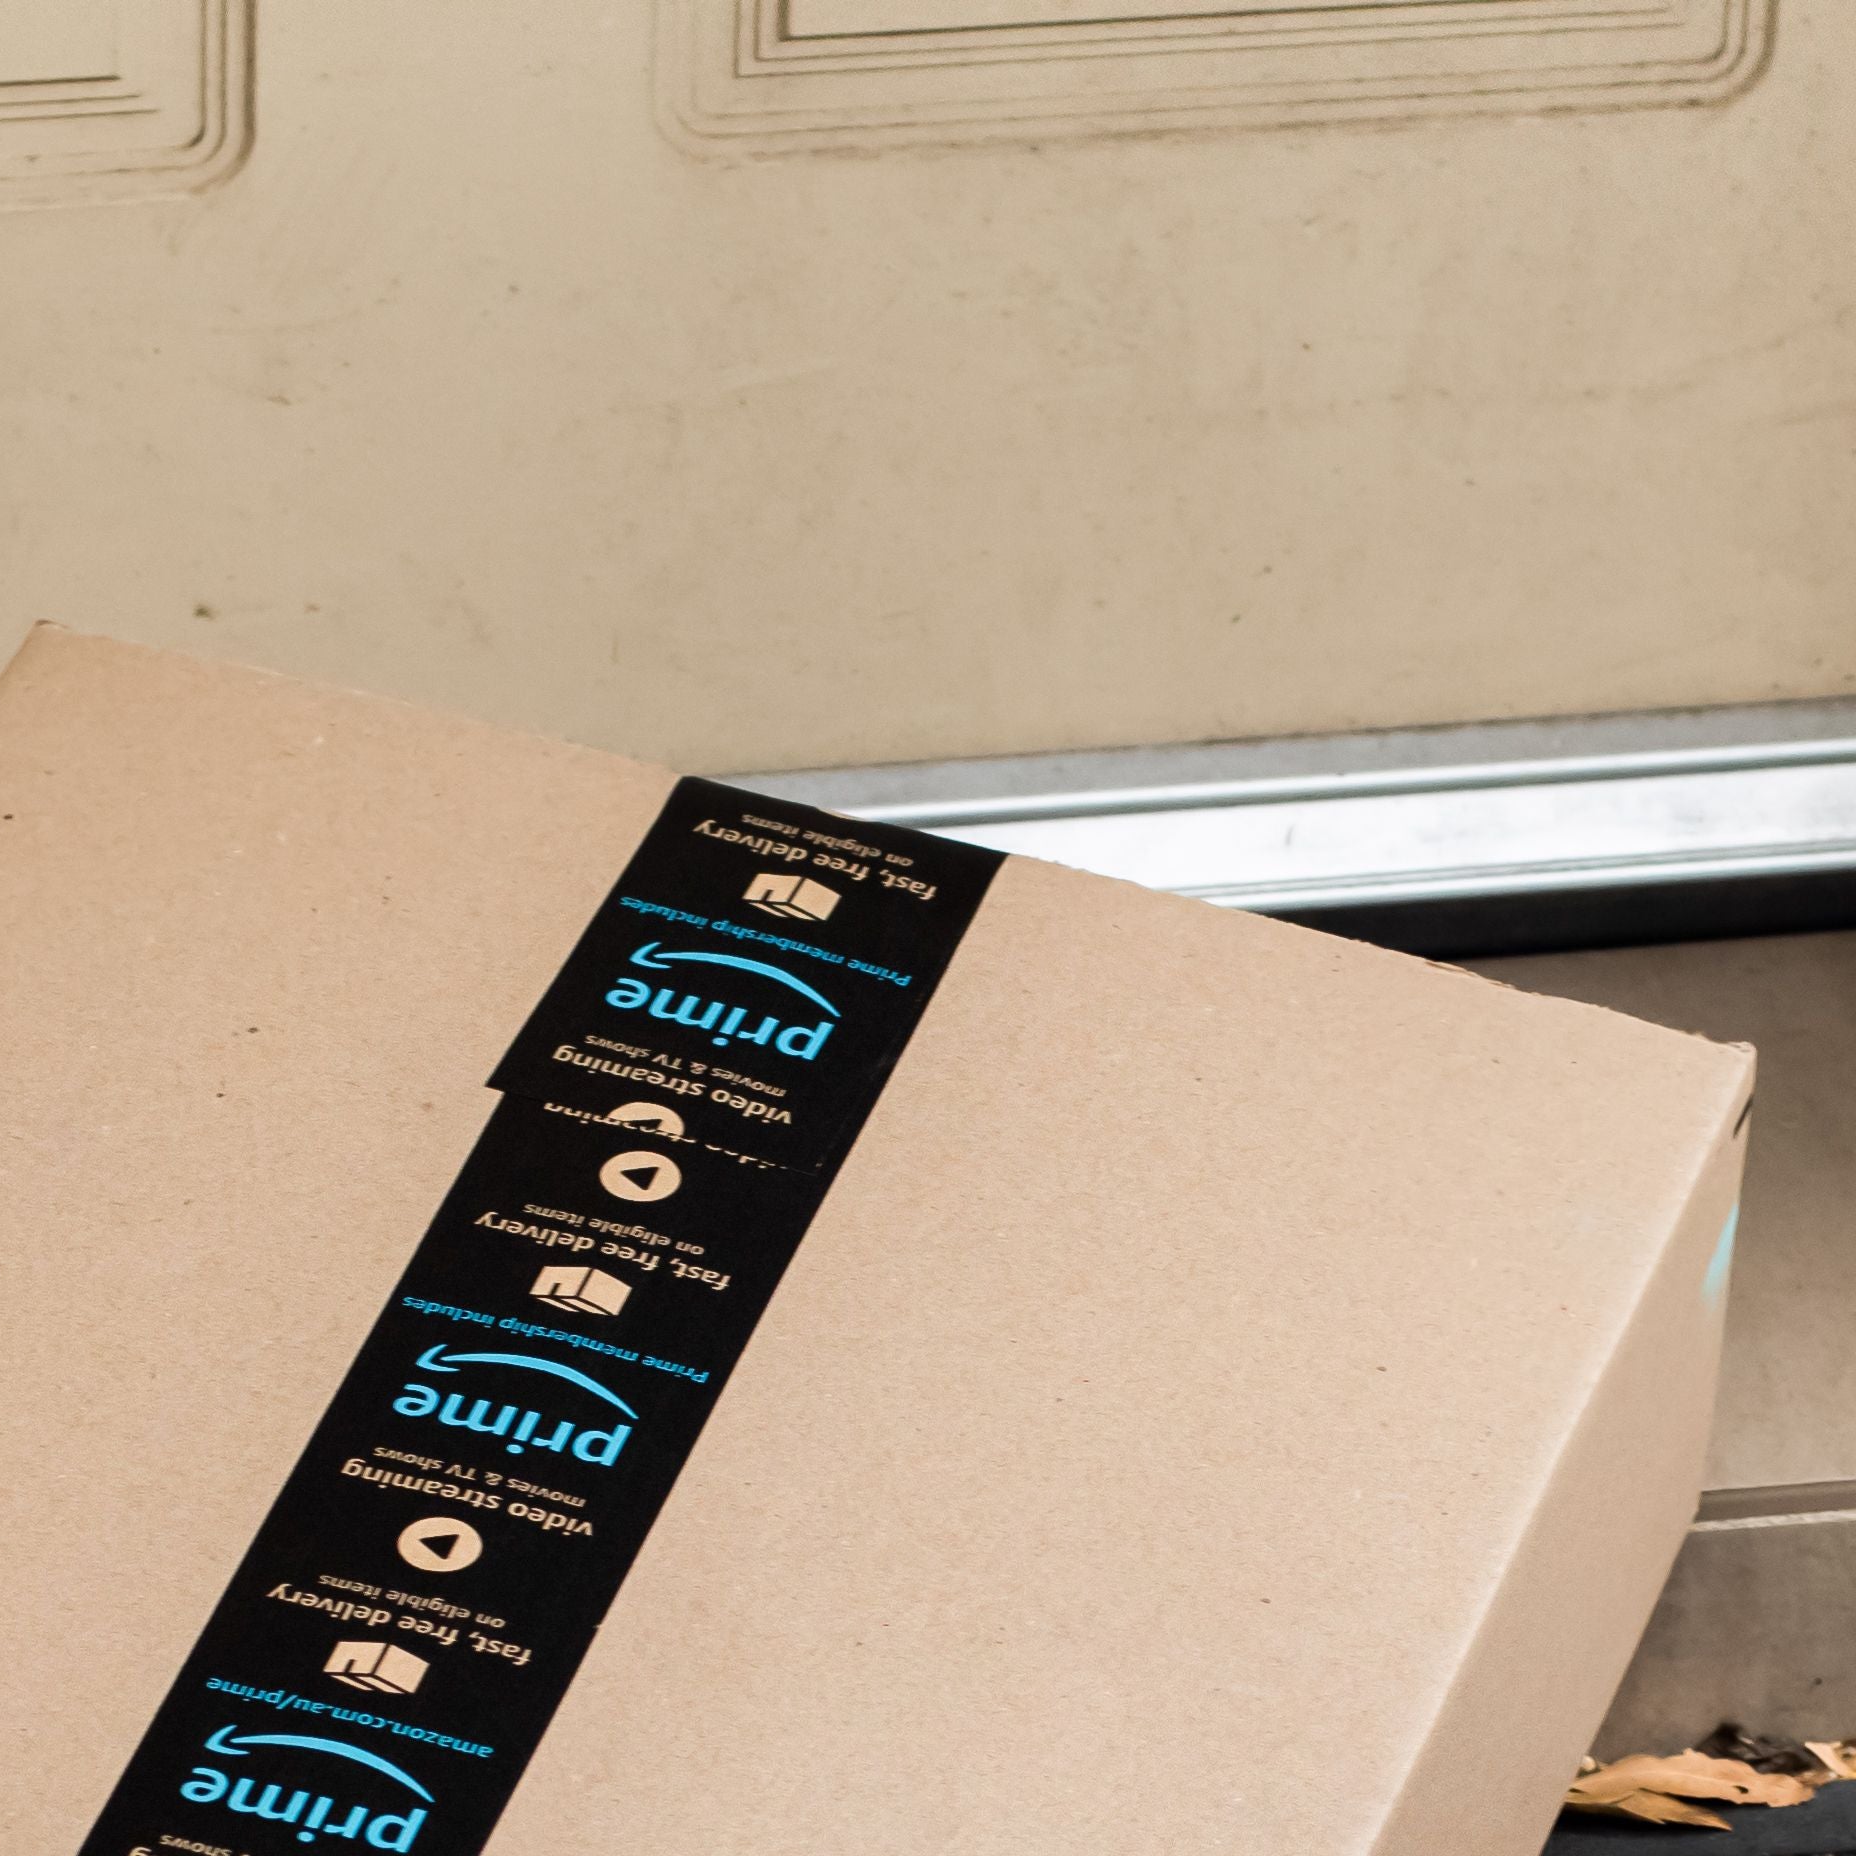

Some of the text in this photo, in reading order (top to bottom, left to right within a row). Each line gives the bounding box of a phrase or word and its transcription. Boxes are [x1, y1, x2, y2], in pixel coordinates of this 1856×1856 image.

[693, 820, 937, 900] fast, free delivery
[742, 815, 913, 866] on eligible items
[620, 897, 912, 986] Prime membership includes
[605, 978, 835, 1060] prime
[552, 1045, 791, 1124] video streaming
[584, 1035, 786, 1096] movies & TV shows
[474, 1212, 731, 1290] fast, free delivery
[522, 1204, 704, 1255] on eligible items
[402, 1297, 709, 1383] Prime membership includes
[392, 1384, 632, 1467] prime
[341, 1458, 592, 1536] video streaming
[373, 1447, 586, 1507] movies & TV shows
[266, 1583, 532, 1666] fast, free delivery
[318, 1575, 506, 1628] on eligible items
[206, 1678, 494, 1758] amazon.com.au/prime
[180, 1767, 428, 1854] prime
